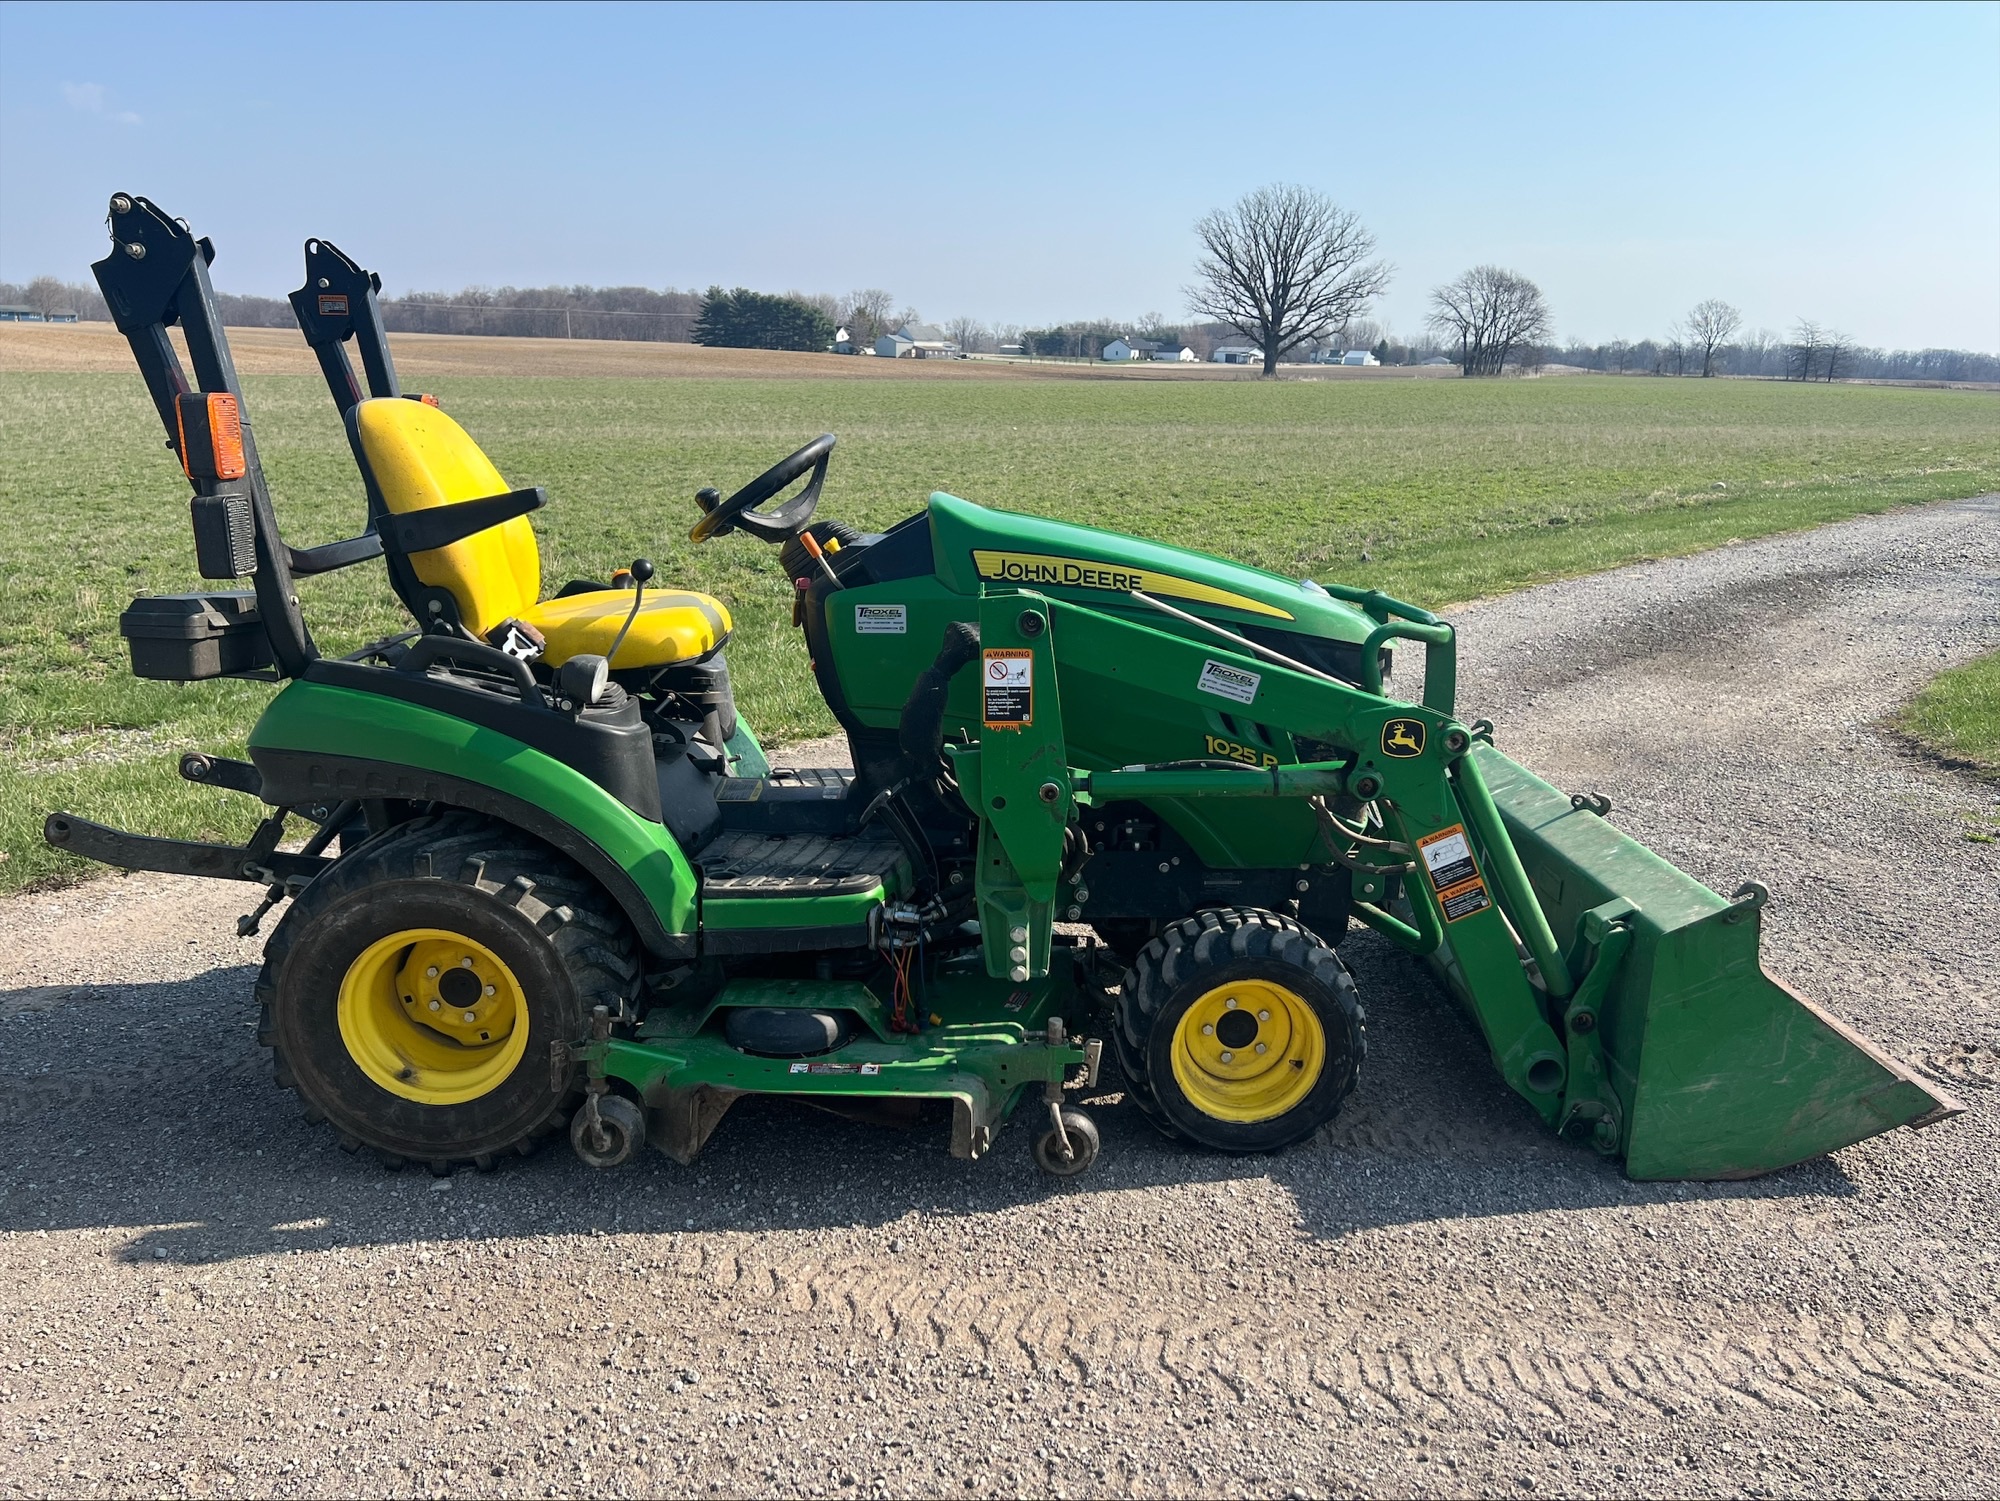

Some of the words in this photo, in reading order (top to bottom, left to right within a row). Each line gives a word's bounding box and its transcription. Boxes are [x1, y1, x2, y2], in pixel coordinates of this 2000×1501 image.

[993, 559, 1057, 581] JOHN
[1064, 563, 1143, 590] DEERE
[858, 607, 902, 617] TROXEL
[992, 650, 1030, 658] WARNING
[1206, 662, 1255, 685] TROXEL
[1205, 735, 1257, 764] 1025
[1428, 827, 1457, 841] WARNING
